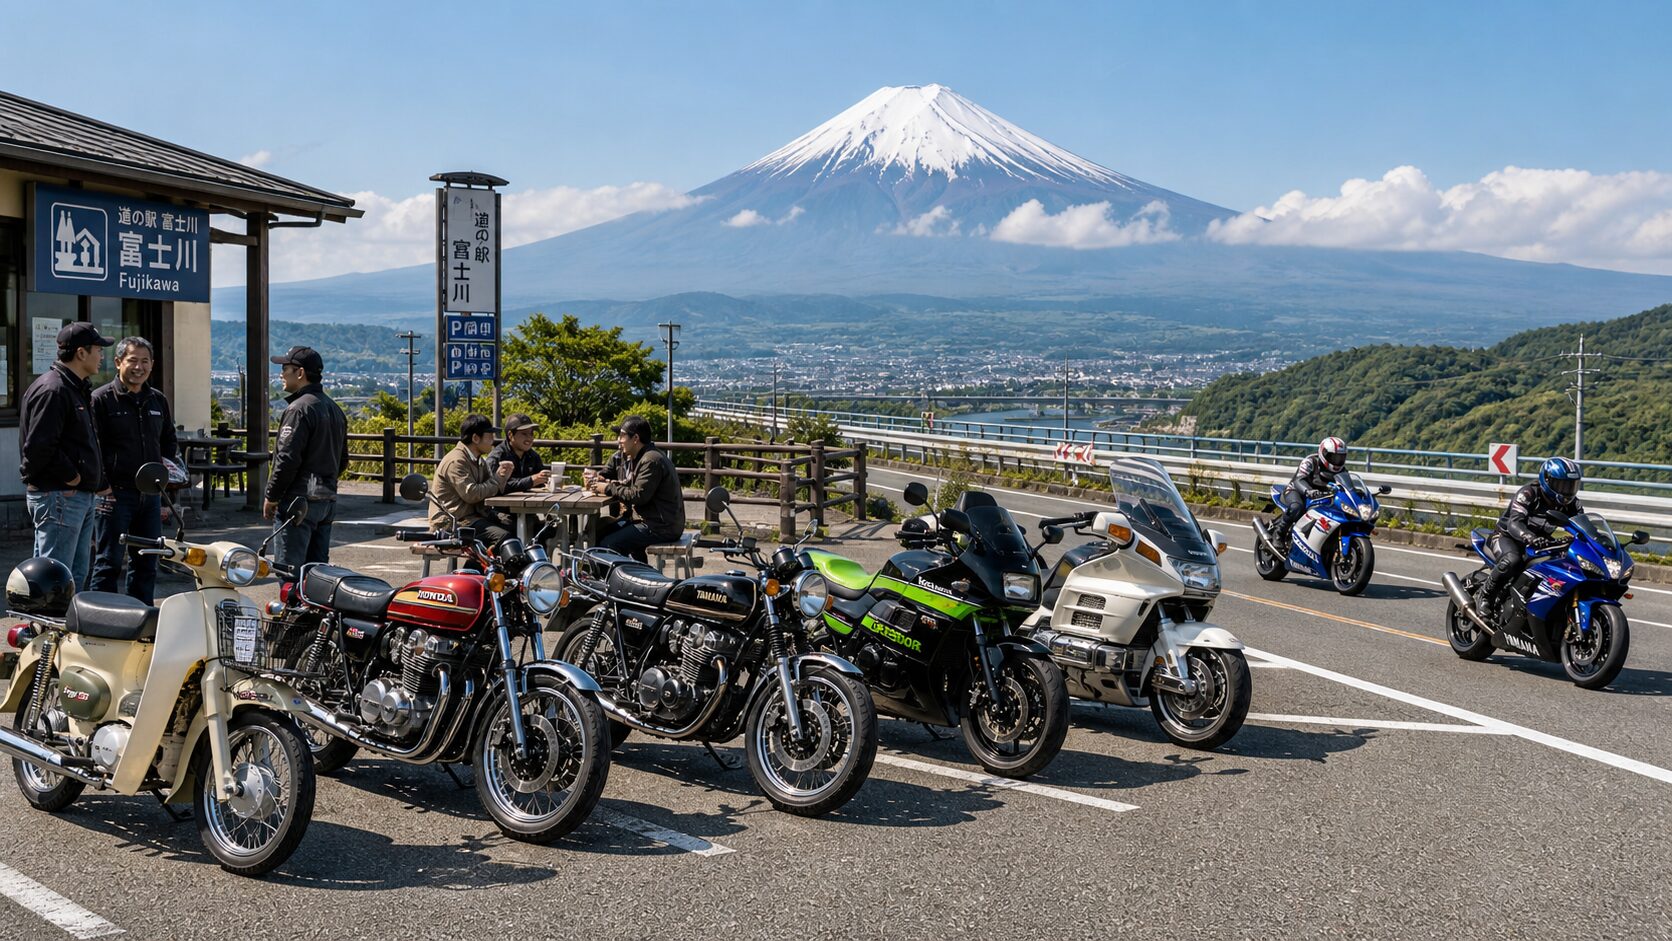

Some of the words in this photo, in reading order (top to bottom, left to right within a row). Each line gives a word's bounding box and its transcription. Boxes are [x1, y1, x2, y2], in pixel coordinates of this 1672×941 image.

[161, 213, 198, 234] 富士川
[118, 230, 197, 273] 富士川
[119, 272, 180, 293] Fujikawa
